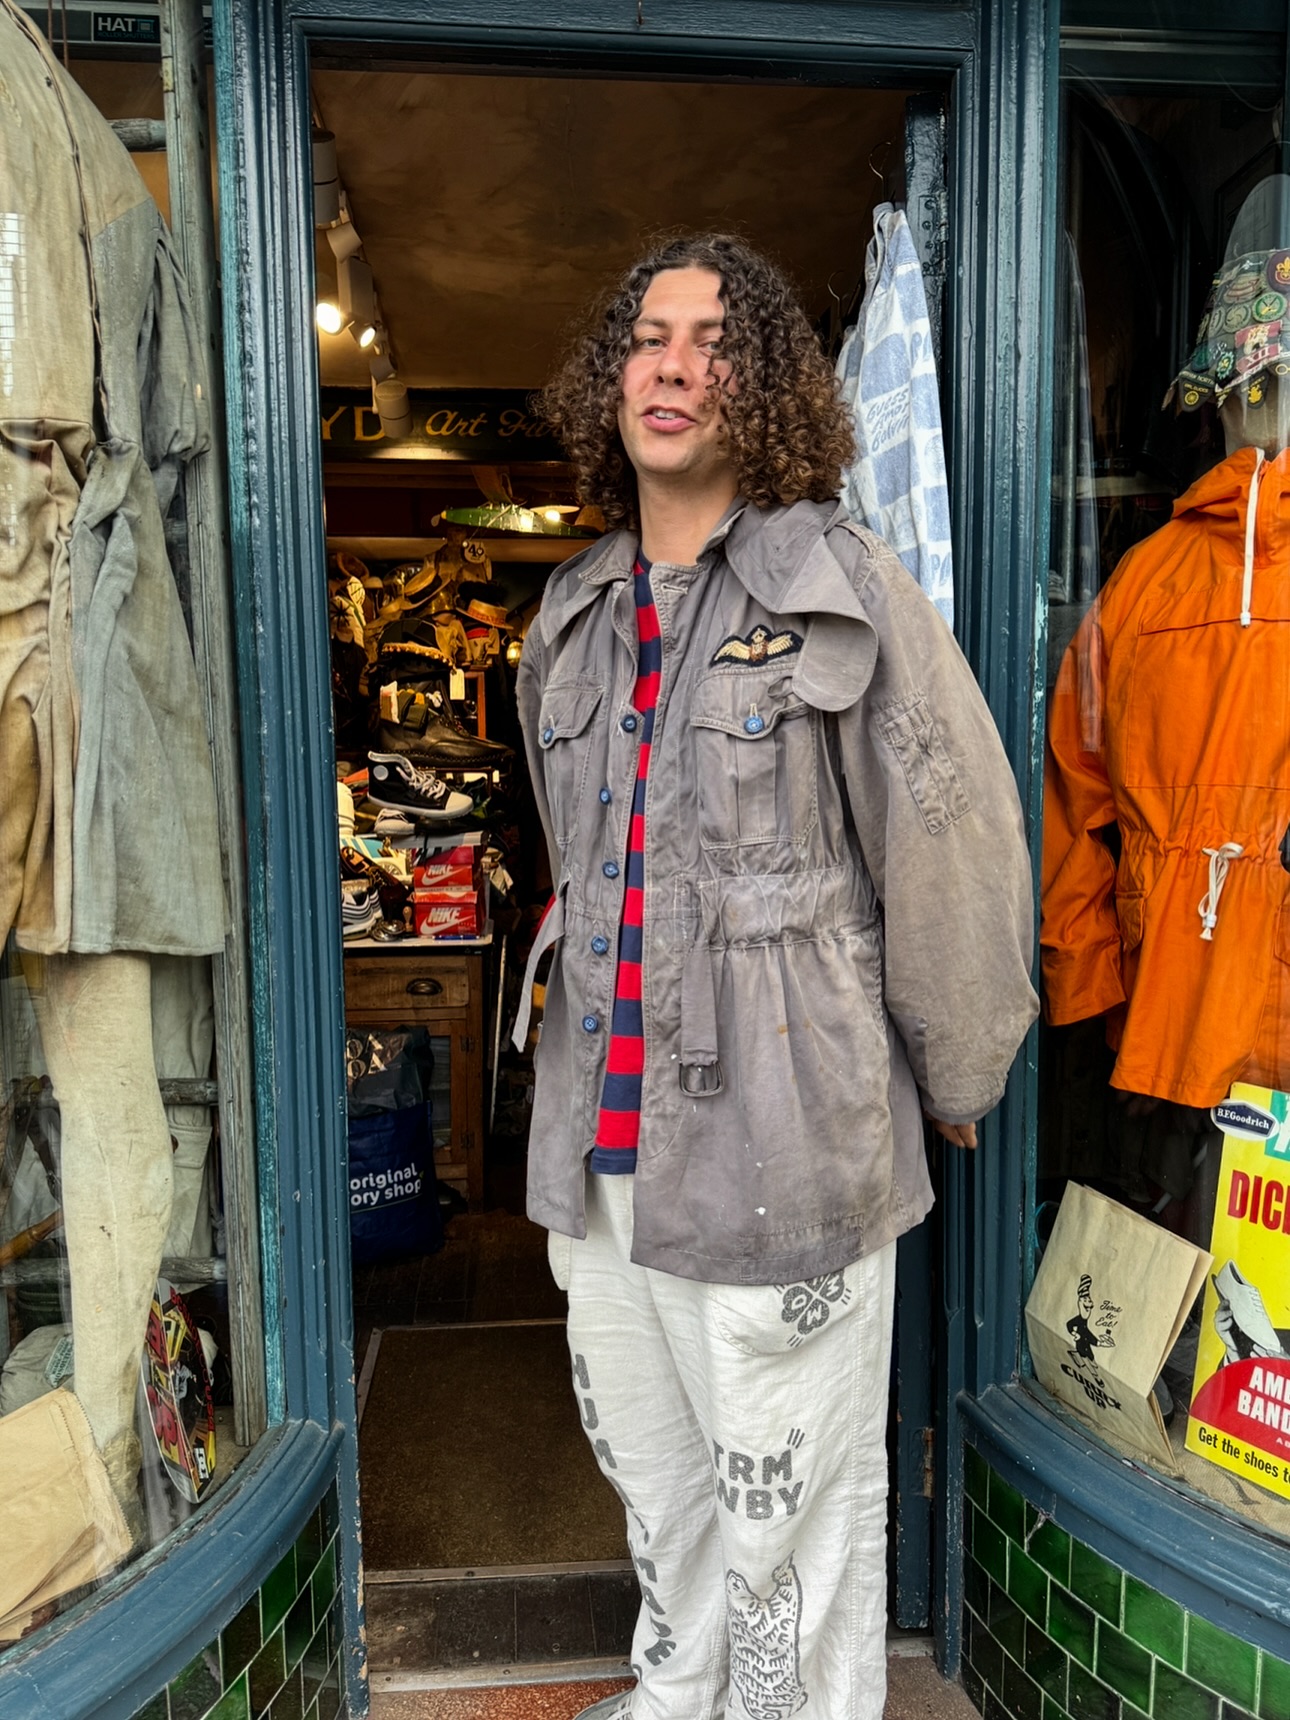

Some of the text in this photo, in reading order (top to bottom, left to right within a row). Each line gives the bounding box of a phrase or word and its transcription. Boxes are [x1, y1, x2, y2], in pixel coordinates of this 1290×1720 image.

[97, 17, 136, 32] HAT
[425, 409, 487, 437] Art
[428, 864, 453, 876] NIKE
[427, 907, 461, 923] NIKE
[350, 1162, 418, 1190] original
[350, 1179, 421, 1206] ory shop
[1227, 1169, 1290, 1236] DIC
[1095, 1318, 1119, 1328] Eat!
[1198, 1426, 1290, 1484] Get the shoes t
